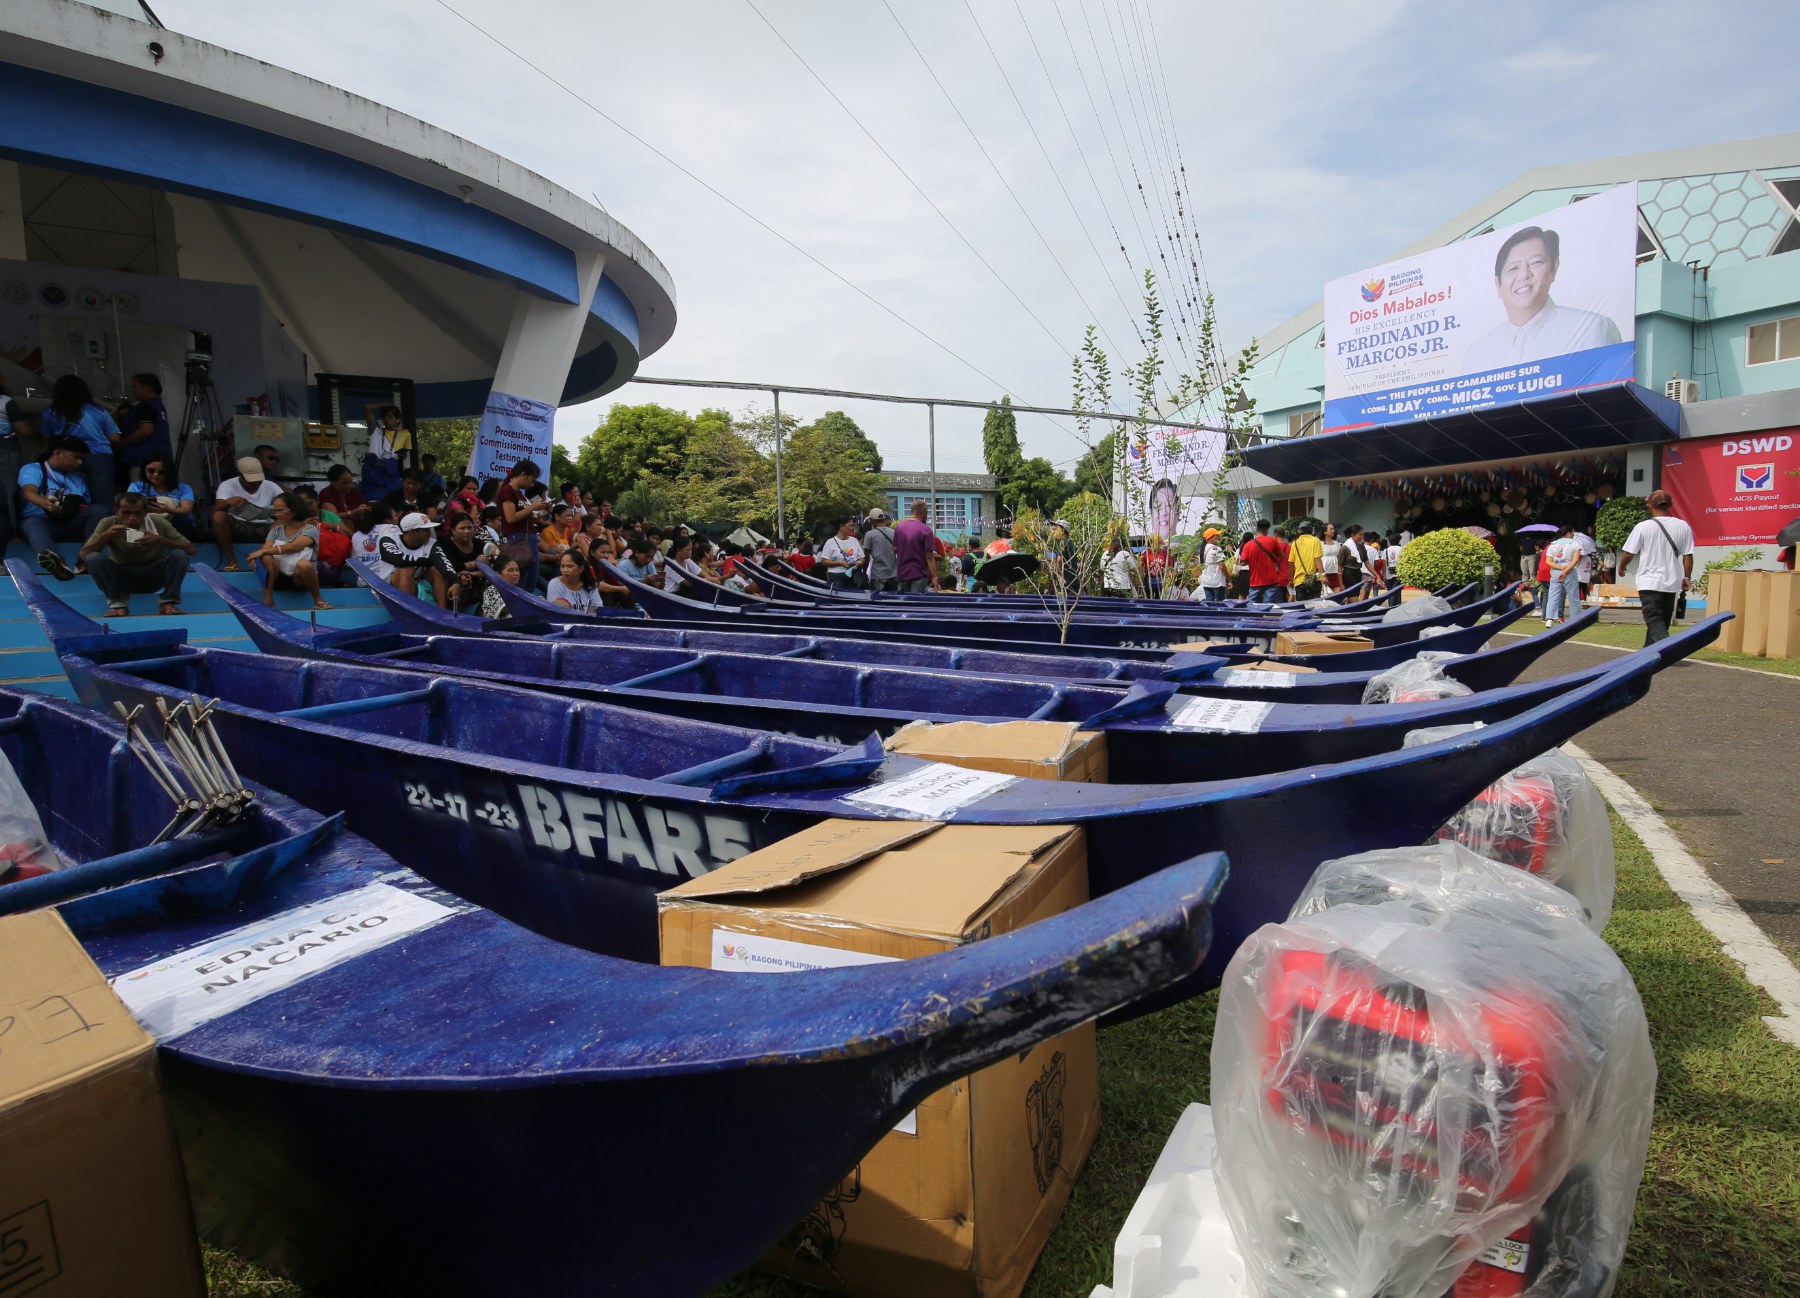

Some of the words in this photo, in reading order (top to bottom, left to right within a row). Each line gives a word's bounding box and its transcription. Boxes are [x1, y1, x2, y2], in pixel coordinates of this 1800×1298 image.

[1389, 274, 1424, 288] PILIPINAS
[1391, 268, 1421, 281] BAGONG
[1349, 309, 1379, 324] Dios
[1355, 325, 1370, 335] HIS
[1373, 308, 1437, 331] EXCELLENCY
[1337, 320, 1440, 355] FERDINAND
[1443, 315, 1461, 331] R.
[1346, 342, 1418, 370] MARCOS
[1421, 336, 1449, 354] JR.
[1347, 381, 1377, 392] REPUBLIC
[1401, 369, 1445, 382] PHILIPPINES
[1389, 391, 1406, 400] THE
[1407, 384, 1440, 397] PEOPLE
[1442, 382, 1455, 391] OF
[1457, 370, 1517, 389] CAMARINES
[1518, 365, 1540, 377] SUR
[1367, 405, 1388, 414] CONG.
[1389, 399, 1424, 415] LRAY,
[1427, 396, 1451, 404] CONG.
[1452, 387, 1494, 405] MIGZ,
[1495, 384, 1517, 393] GOV.
[1518, 374, 1562, 394] LUIGI
[495, 426, 535, 442] Processing,
[1202, 440, 1210, 449] R.
[480, 436, 533, 454] Commissioning
[534, 446, 548, 455] and
[1722, 435, 1793, 456] DSWD
[1705, 506, 1717, 514] (for
[1745, 503, 1777, 511] identified
[1754, 494, 1780, 502] Payout
[922, 775, 981, 799] MATIAS
[404, 782, 519, 830] 22-17-23
[194, 928, 315, 976] EDNA
[321, 909, 360, 926] C.
[200, 914, 390, 995] NACARIO
[751, 954, 783, 966] BAGONG
[1505, 1241, 1523, 1250] LOCK
